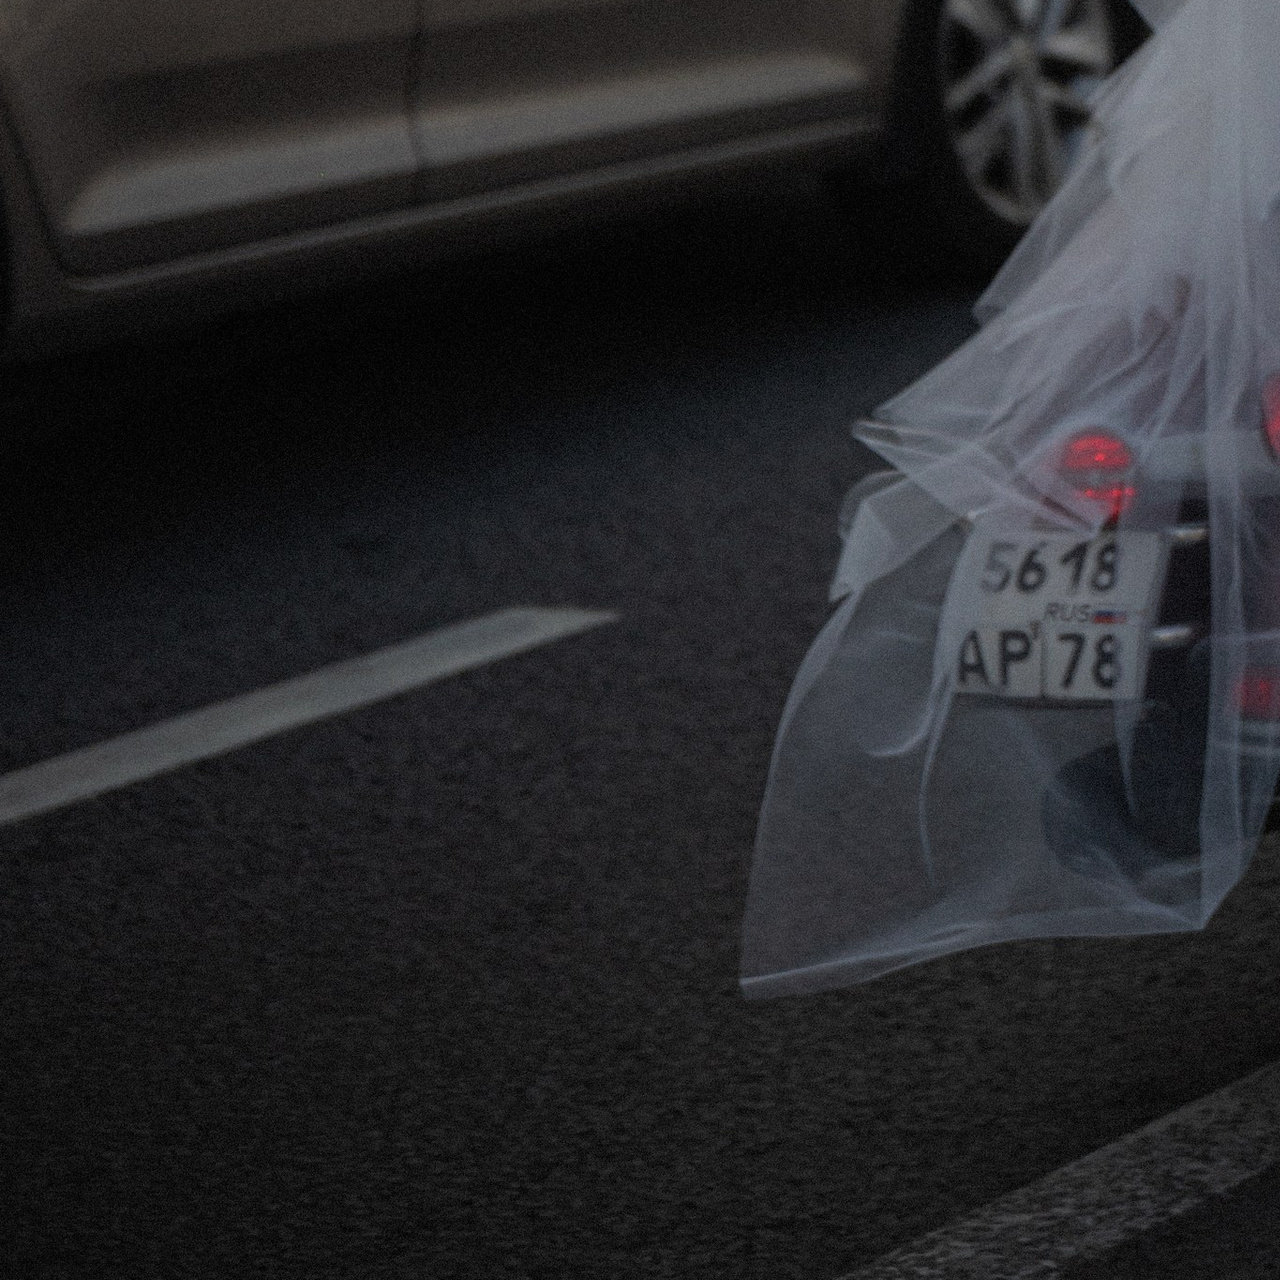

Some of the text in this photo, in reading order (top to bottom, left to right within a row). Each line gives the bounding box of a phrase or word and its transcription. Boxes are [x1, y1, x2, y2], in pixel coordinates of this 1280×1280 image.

[981, 542, 1117, 592] 5618
[1044, 602, 1092, 623] RUS
[1058, 632, 1122, 689] 78
